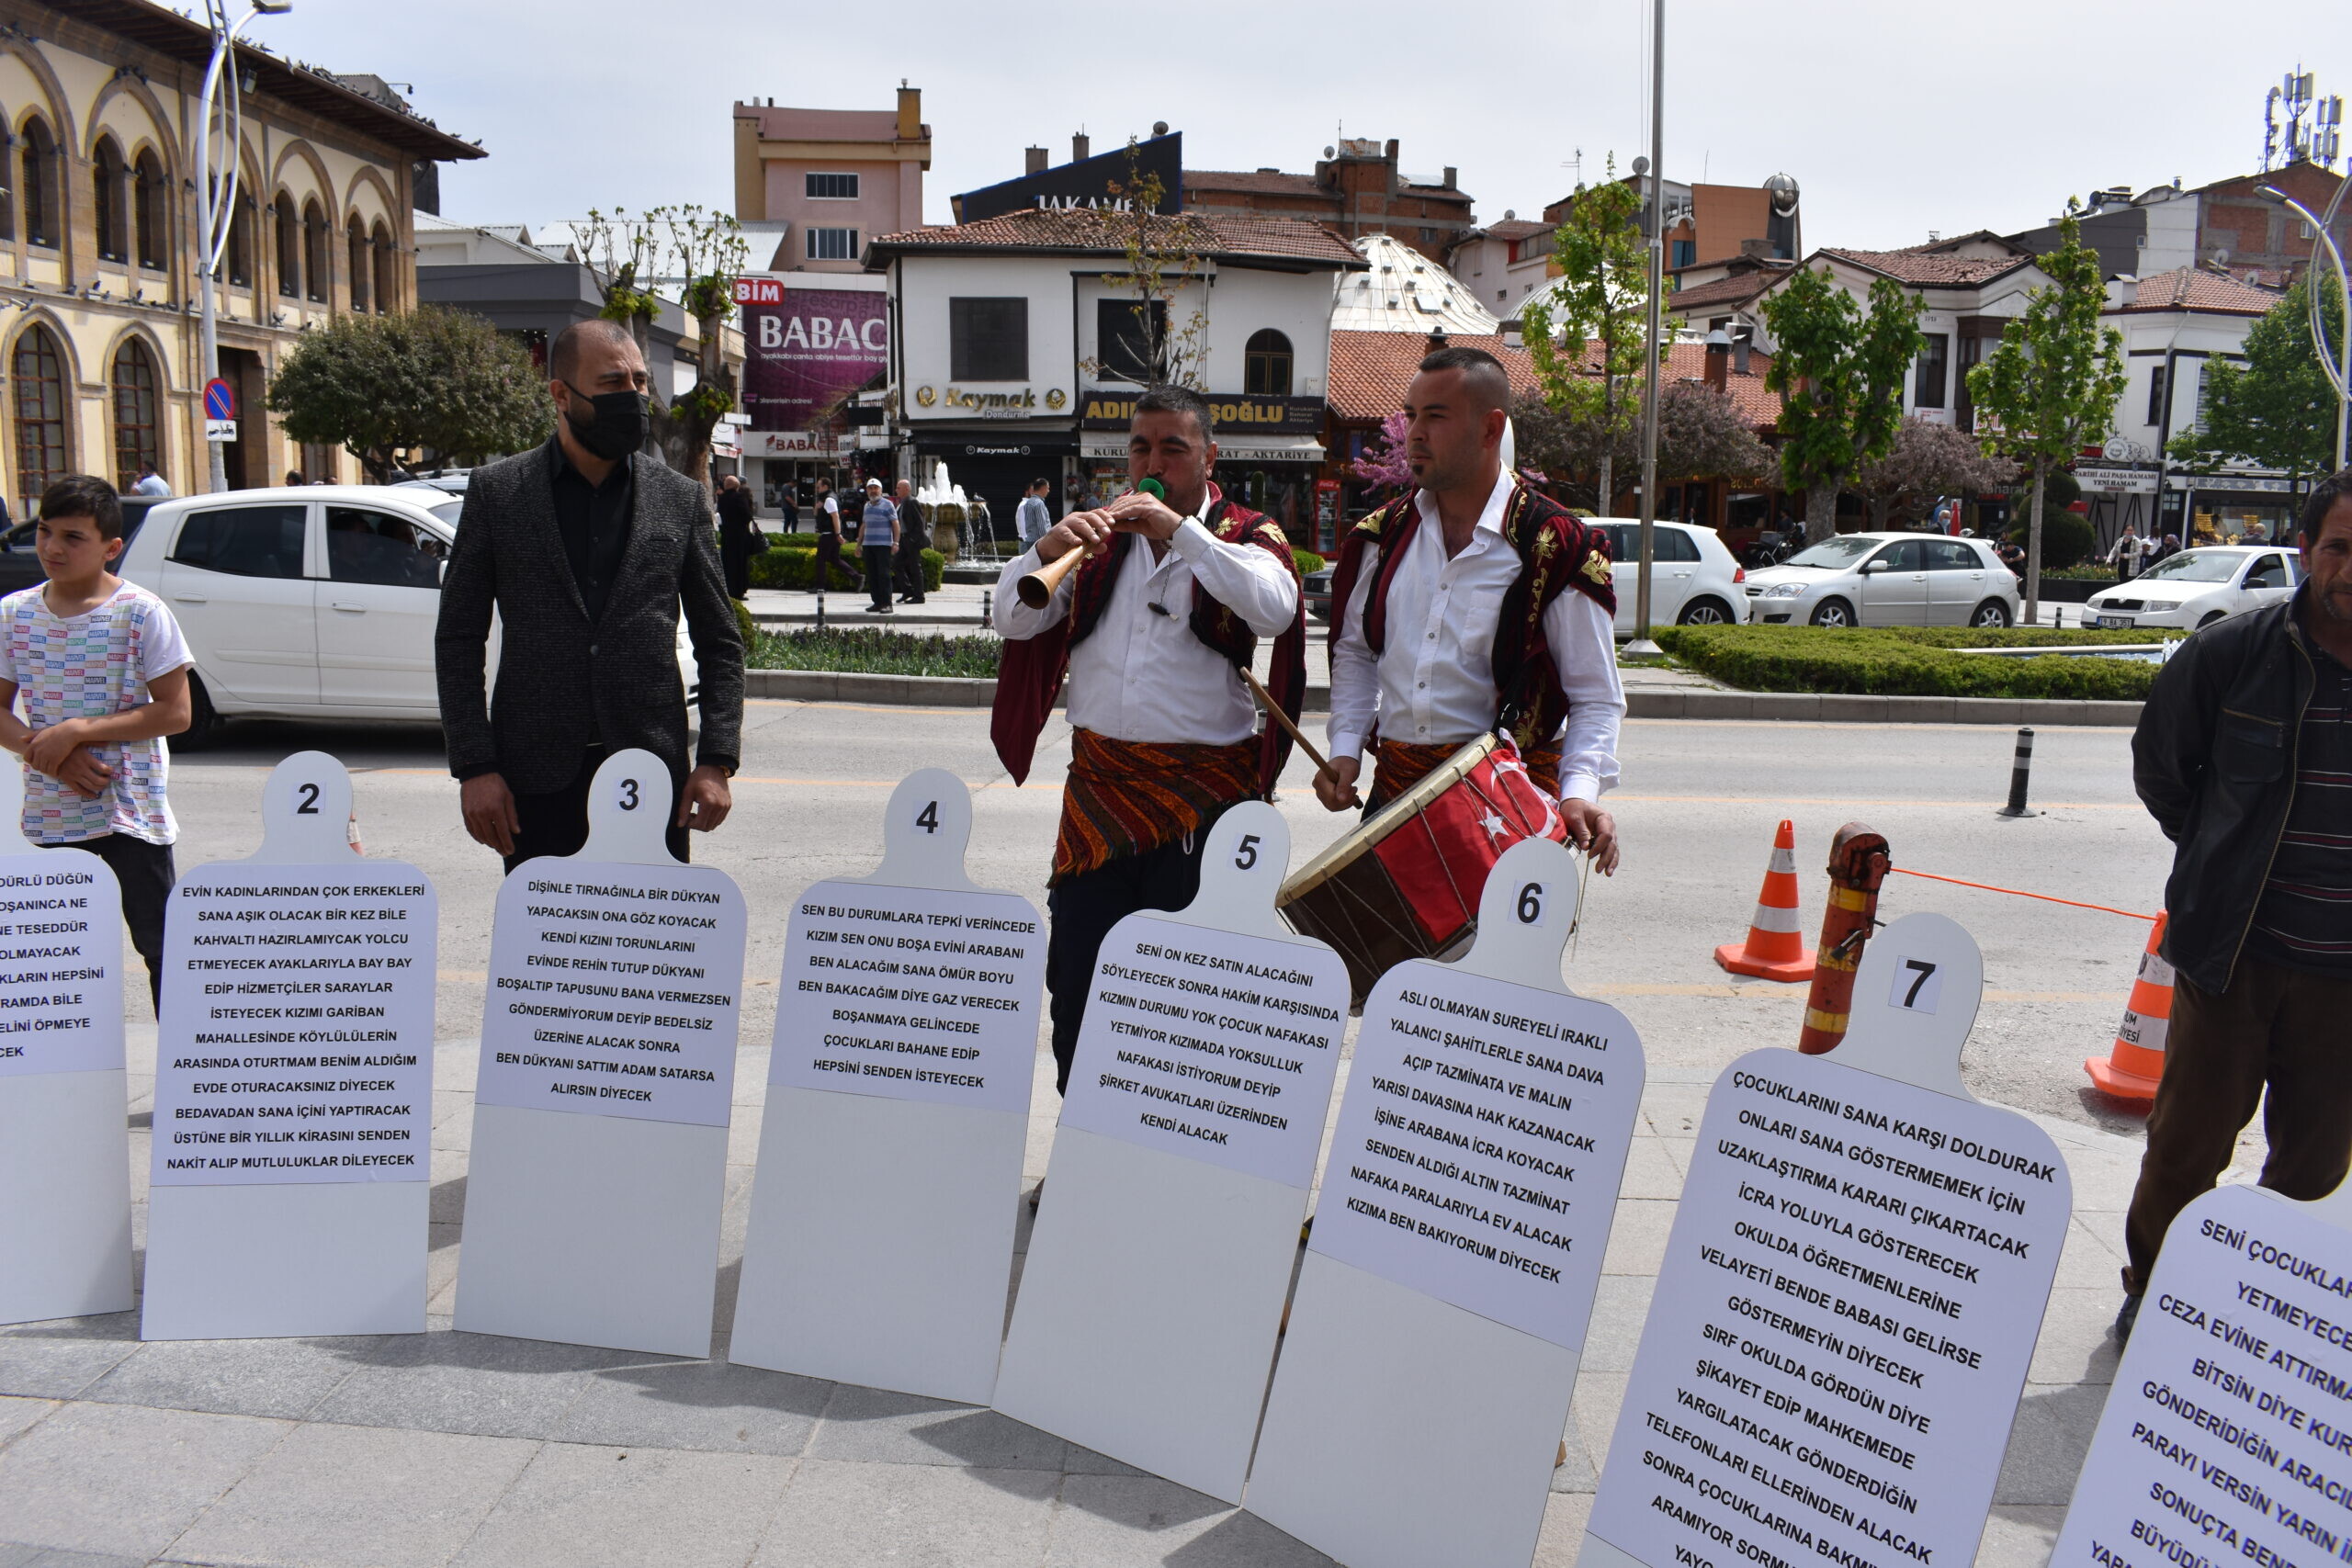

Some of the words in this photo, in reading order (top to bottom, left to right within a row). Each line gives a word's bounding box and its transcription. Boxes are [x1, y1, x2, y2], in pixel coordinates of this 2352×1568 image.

[736, 279, 779, 302] BİM
[945, 388, 1036, 412] Kaymak
[985, 410, 1030, 419] Dondurma
[977, 446, 1020, 455] Kaymak
[1093, 448, 1130, 457] KURU
[298, 784, 320, 815] 2
[618, 778, 639, 811] 3
[915, 800, 939, 834] 4
[1235, 834, 1261, 871] 5
[46, 872, 94, 886] DÜĞÜN
[182, 885, 212, 897] EVİN
[215, 886, 320, 897] KADINLARINDAN
[322, 886, 350, 899] ÇOK
[353, 884, 425, 897] ERKEKLERİ
[527, 879, 573, 895] DİŞİNLE
[575, 884, 646, 899] TIRNAĞINLA
[648, 887, 669, 901] BİR
[671, 889, 720, 904] DÜKYAN
[198, 910, 233, 921] SANA
[235, 910, 266, 923] AŞIK
[268, 910, 322, 921] OLACAK
[325, 908, 347, 920] BİR
[350, 909, 376, 920] KEZ
[379, 908, 407, 920] BİLE
[1517, 882, 1543, 924] 6
[801, 904, 826, 917] SEN
[828, 906, 845, 918] BU
[847, 908, 924, 925] DURUMLARA
[926, 914, 963, 928] TEPKİ
[965, 917, 1036, 934] VERİNCEDE
[541, 931, 577, 944] KENDİ
[579, 934, 613, 947] KIZINI
[615, 936, 695, 953] TORUNLARINI
[1136, 942, 1163, 958] SENİ
[1164, 948, 1182, 962] ON
[1183, 952, 1208, 967] KEZ
[1208, 956, 1244, 974] SATIN
[1244, 964, 1314, 987] ALACAĞINI
[52, 992, 83, 1006] BİLE
[204, 981, 234, 995] EDİP
[237, 980, 322, 996] HİZMETÇİLER
[324, 982, 393, 994] SARAYLAR
[496, 977, 553, 992] BOŞALTIP
[555, 982, 618, 998] TAPUSUNU
[620, 987, 655, 1000] BANA
[657, 990, 731, 1007] VERMEZSEN
[797, 979, 823, 993] BEN
[825, 982, 899, 1000] BAKACAĞIM
[900, 987, 930, 1003] DİYE
[932, 993, 958, 1006] GAZ
[960, 995, 1020, 1012] VERECEK
[1903, 959, 1937, 1009] 7
[1099, 990, 1137, 1009] KIZMIN
[1138, 998, 1190, 1020] DURUMU
[1192, 1010, 1217, 1026] YOK
[1218, 1016, 1263, 1036] ÇOCUK
[1264, 1025, 1329, 1050] NAFAKASI
[1398, 989, 1428, 1008] ASLI
[1430, 997, 1490, 1022] OLMAYAN
[1492, 1011, 1560, 1040] SUREYELİ
[1560, 1028, 1609, 1052] IRAKLI
[173, 1057, 241, 1069] ARASINDA
[243, 1056, 317, 1068] OTURTMAM
[320, 1054, 361, 1067] BENİM
[363, 1053, 417, 1066] ALDIĞIM
[495, 1052, 521, 1065] BEN
[523, 1053, 574, 1069] DÜKYANI
[576, 1059, 619, 1074] SATTIM
[620, 1064, 657, 1077] ADAM
[659, 1066, 716, 1082] SATARSA
[813, 1058, 861, 1075] HEPSİNİ
[863, 1064, 912, 1080] SENDEN
[915, 1067, 985, 1089] İSTEYECEK
[1372, 1076, 1410, 1099] YARISI
[1411, 1088, 1474, 1118] DAVASINA
[1476, 1106, 1506, 1127] HAK
[1507, 1115, 1596, 1153] KAZANACAK
[1733, 1071, 1840, 1116] ÇOCUKLARINI
[1842, 1104, 1889, 1132] SANA
[1892, 1119, 1948, 1150] KARŞI
[1950, 1136, 2057, 1184] DOLDURAK
[167, 1156, 207, 1169] NAKİT
[209, 1157, 239, 1168] ALIP
[242, 1156, 339, 1168] MUTLULUKLAR
[342, 1153, 415, 1167] DİLEYECEK
[1346, 1196, 1386, 1223] KIZIMA
[1388, 1212, 1416, 1232] BEN
[1417, 1221, 1498, 1261] BAKIYORUM
[1498, 1250, 1562, 1284] DİYECEK
[1737, 1180, 1775, 1211] İCRA
[1781, 1198, 1853, 1239] YOLUYLA
[1858, 1227, 1980, 1284] GÖSTERECEK
[2200, 1218, 2247, 1251] SENİ
[1702, 1245, 1773, 1286] VELAYETİ
[1773, 1274, 1832, 1310] BENDE
[1833, 1298, 1900, 1337] BABASI
[1902, 1326, 1983, 1371] GELİRSE
[2158, 1293, 2205, 1331] CEZA
[2209, 1317, 2268, 1360] EVİNE
[1677, 1387, 1794, 1456] YARGILATACAK
[1796, 1446, 1917, 1515] GÖNDERDİĞİN
[1646, 1411, 1749, 1474] TELEFONLARI
[1750, 1463, 1855, 1528] ELLERİNDEN
[1855, 1517, 1933, 1565] ALACAK
